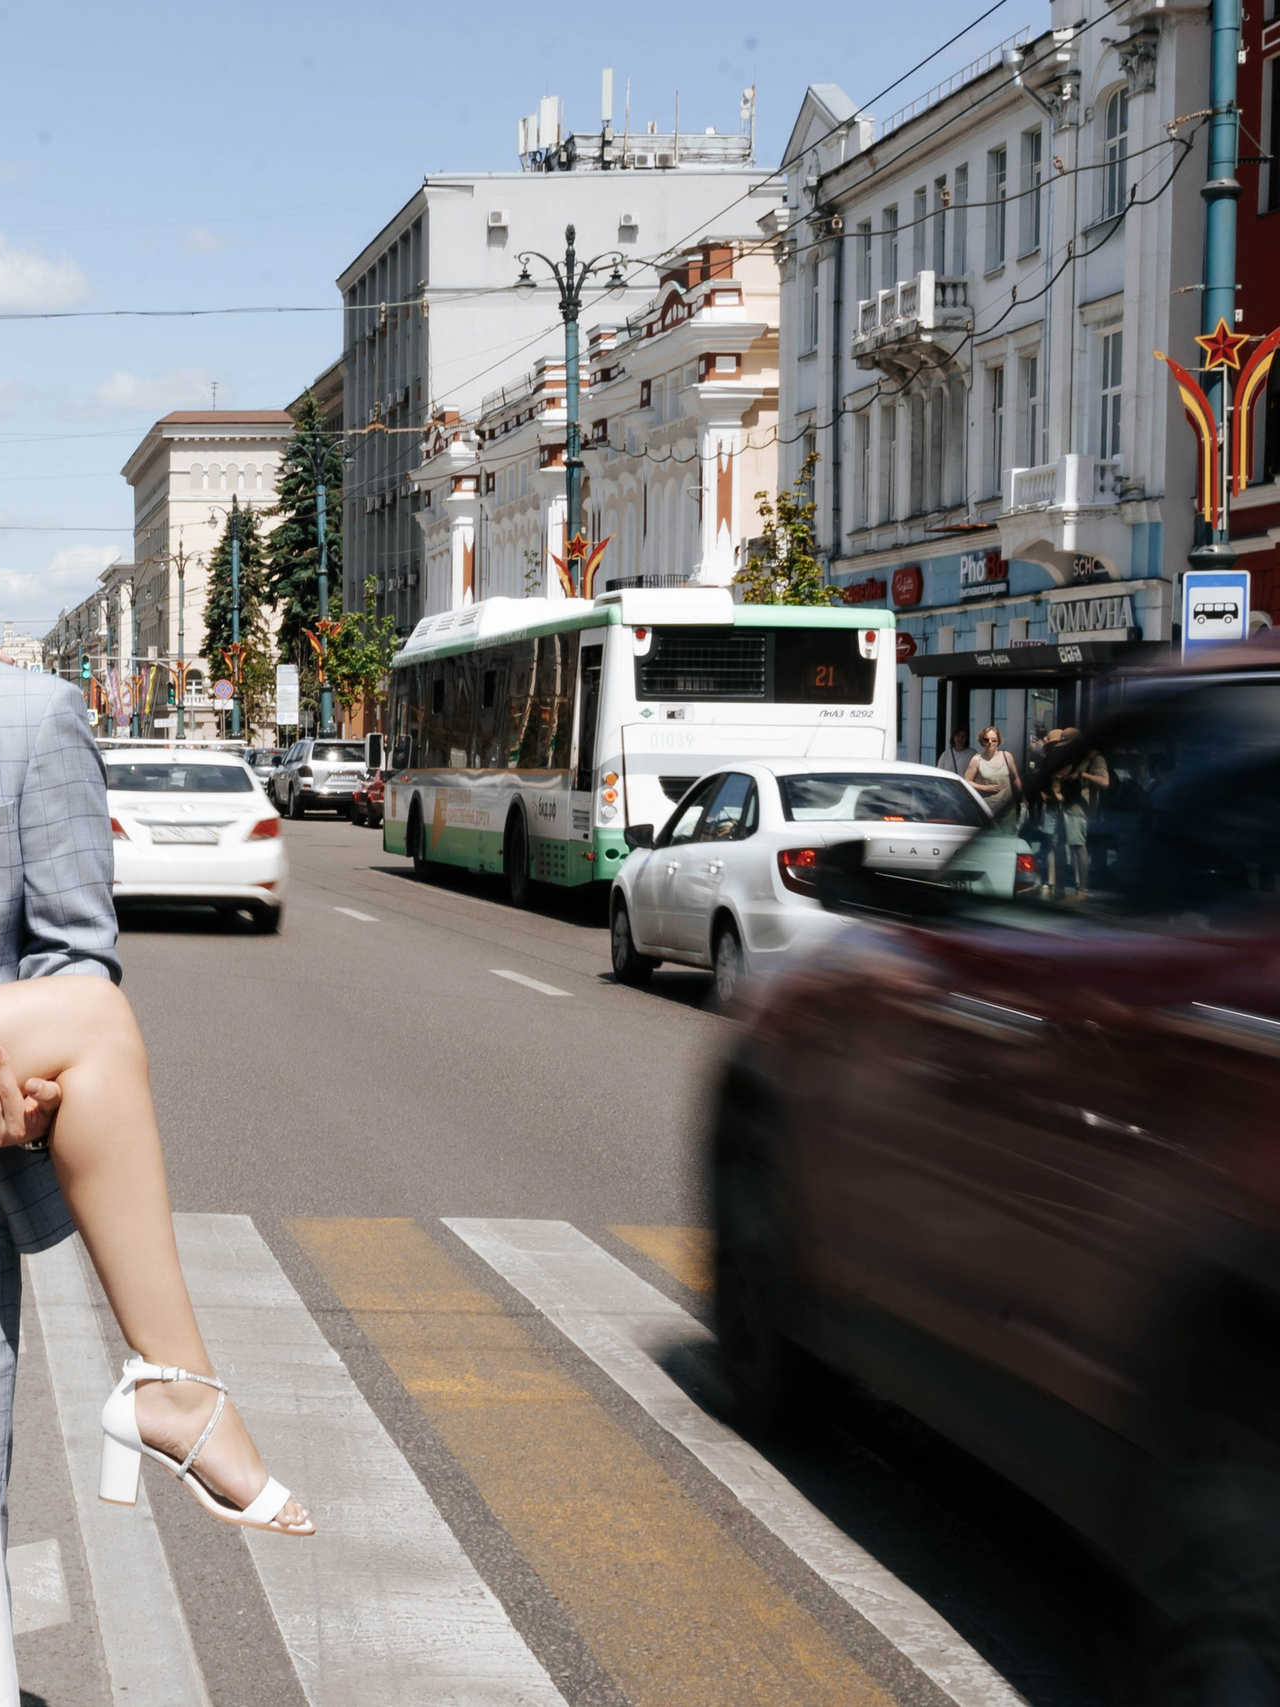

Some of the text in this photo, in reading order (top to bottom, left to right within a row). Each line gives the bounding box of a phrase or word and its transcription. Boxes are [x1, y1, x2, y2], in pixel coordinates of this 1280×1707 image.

[1047, 596, 1134, 634] КОММУНА
[815, 665, 834, 687] 21
[849, 710, 874, 718] 5292
[650, 733, 693, 748] 01039
